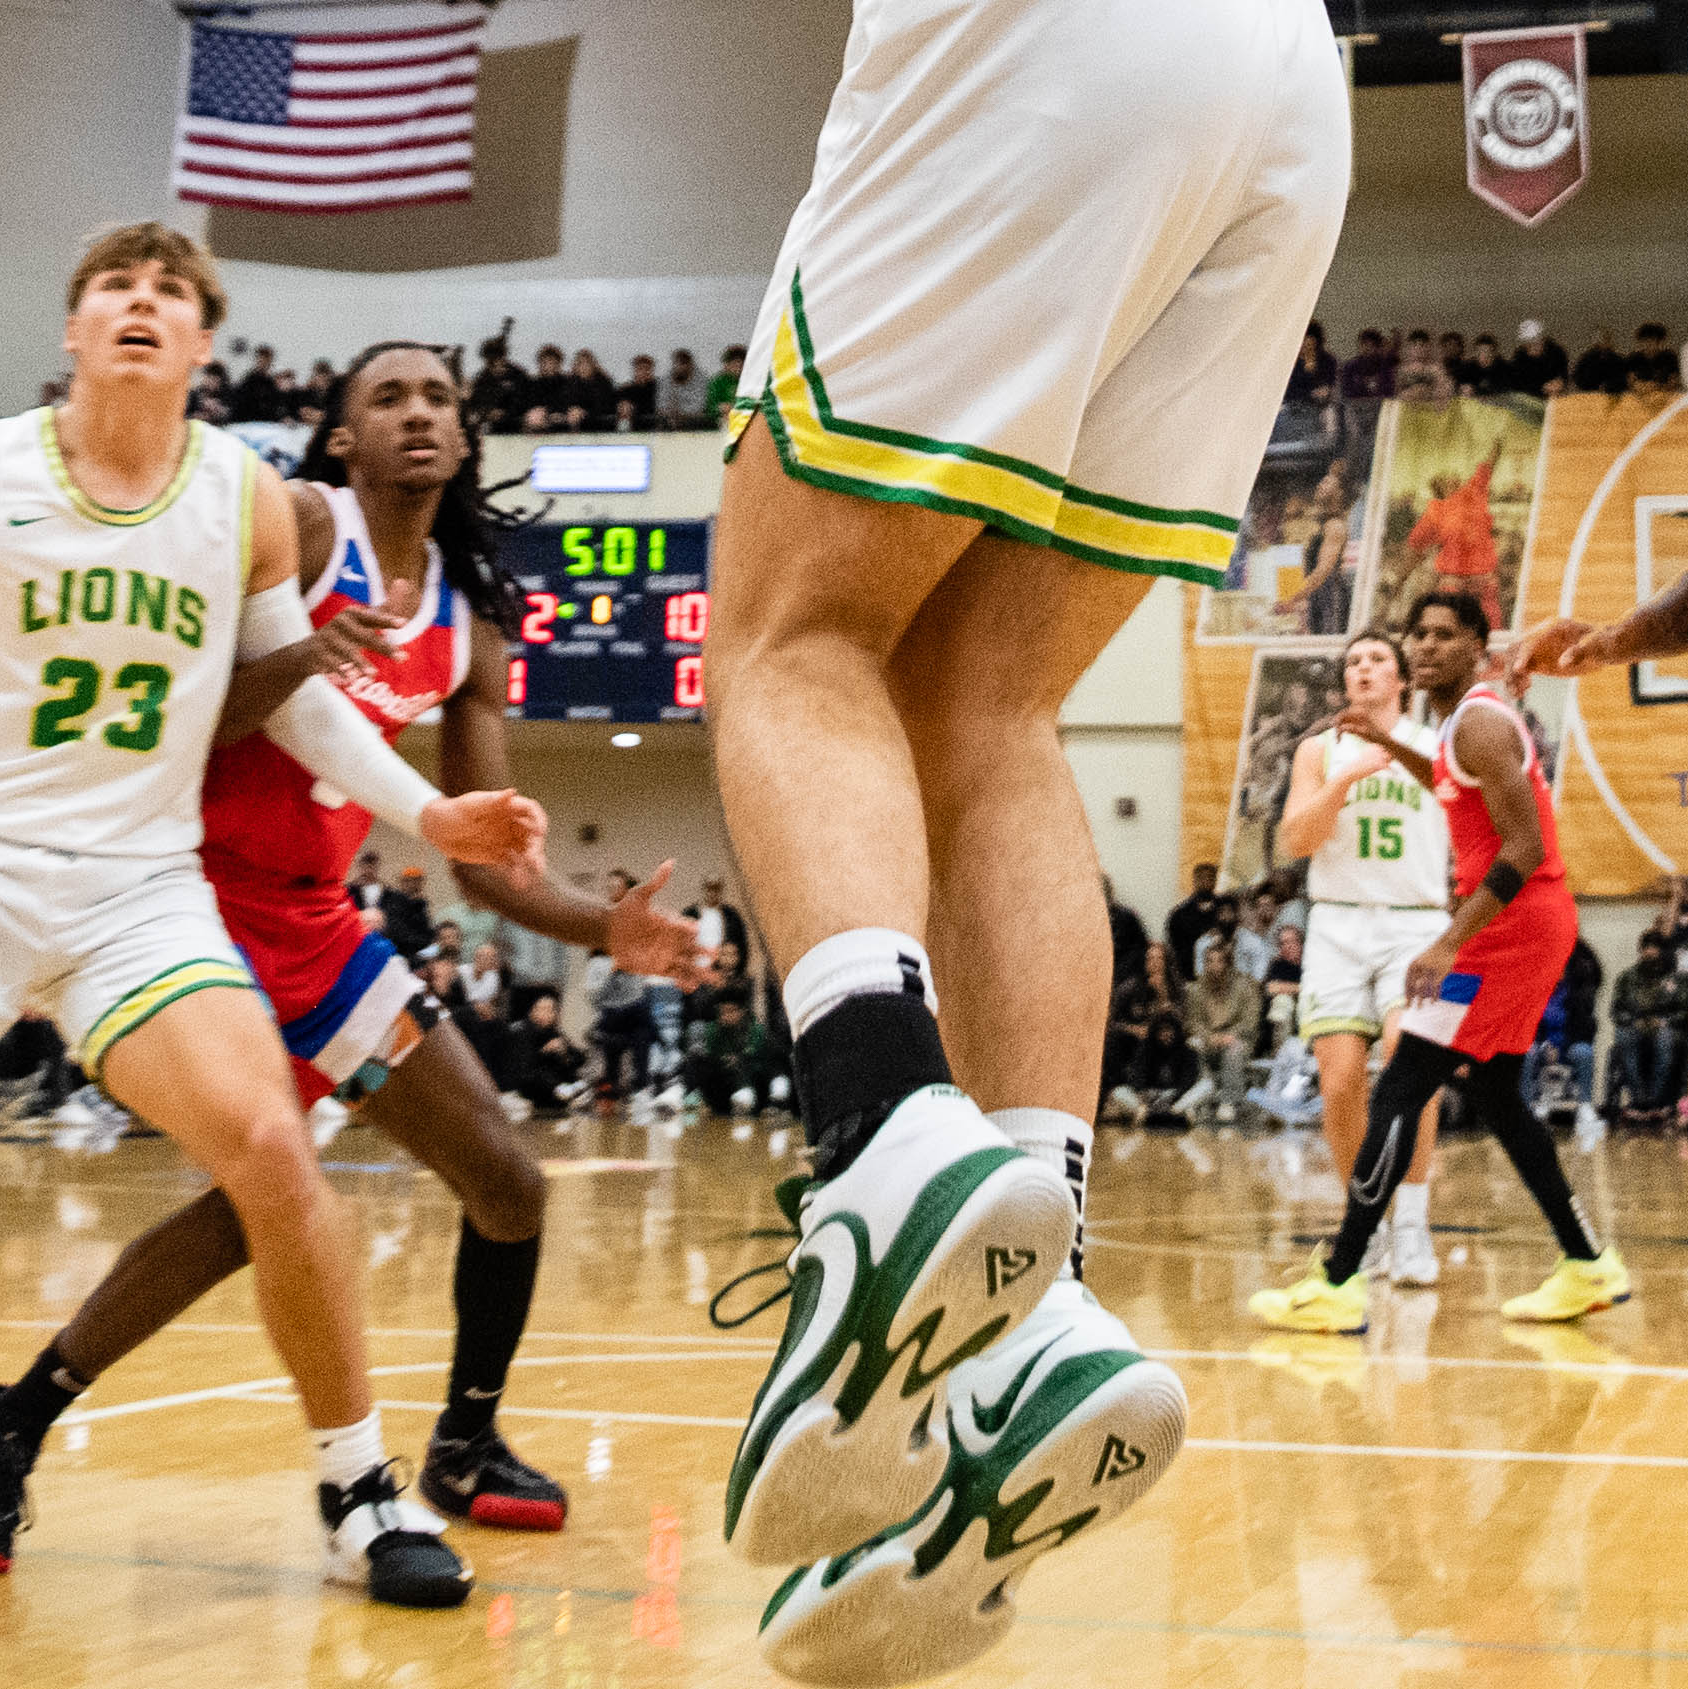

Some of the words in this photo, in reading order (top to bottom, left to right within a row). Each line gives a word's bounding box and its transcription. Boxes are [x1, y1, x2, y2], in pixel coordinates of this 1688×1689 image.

[21, 566, 208, 650] LIONS
[664, 590, 711, 644] 10
[30, 656, 174, 753] 23
[674, 654, 706, 708] 0
[1356, 815, 1404, 861] 15
